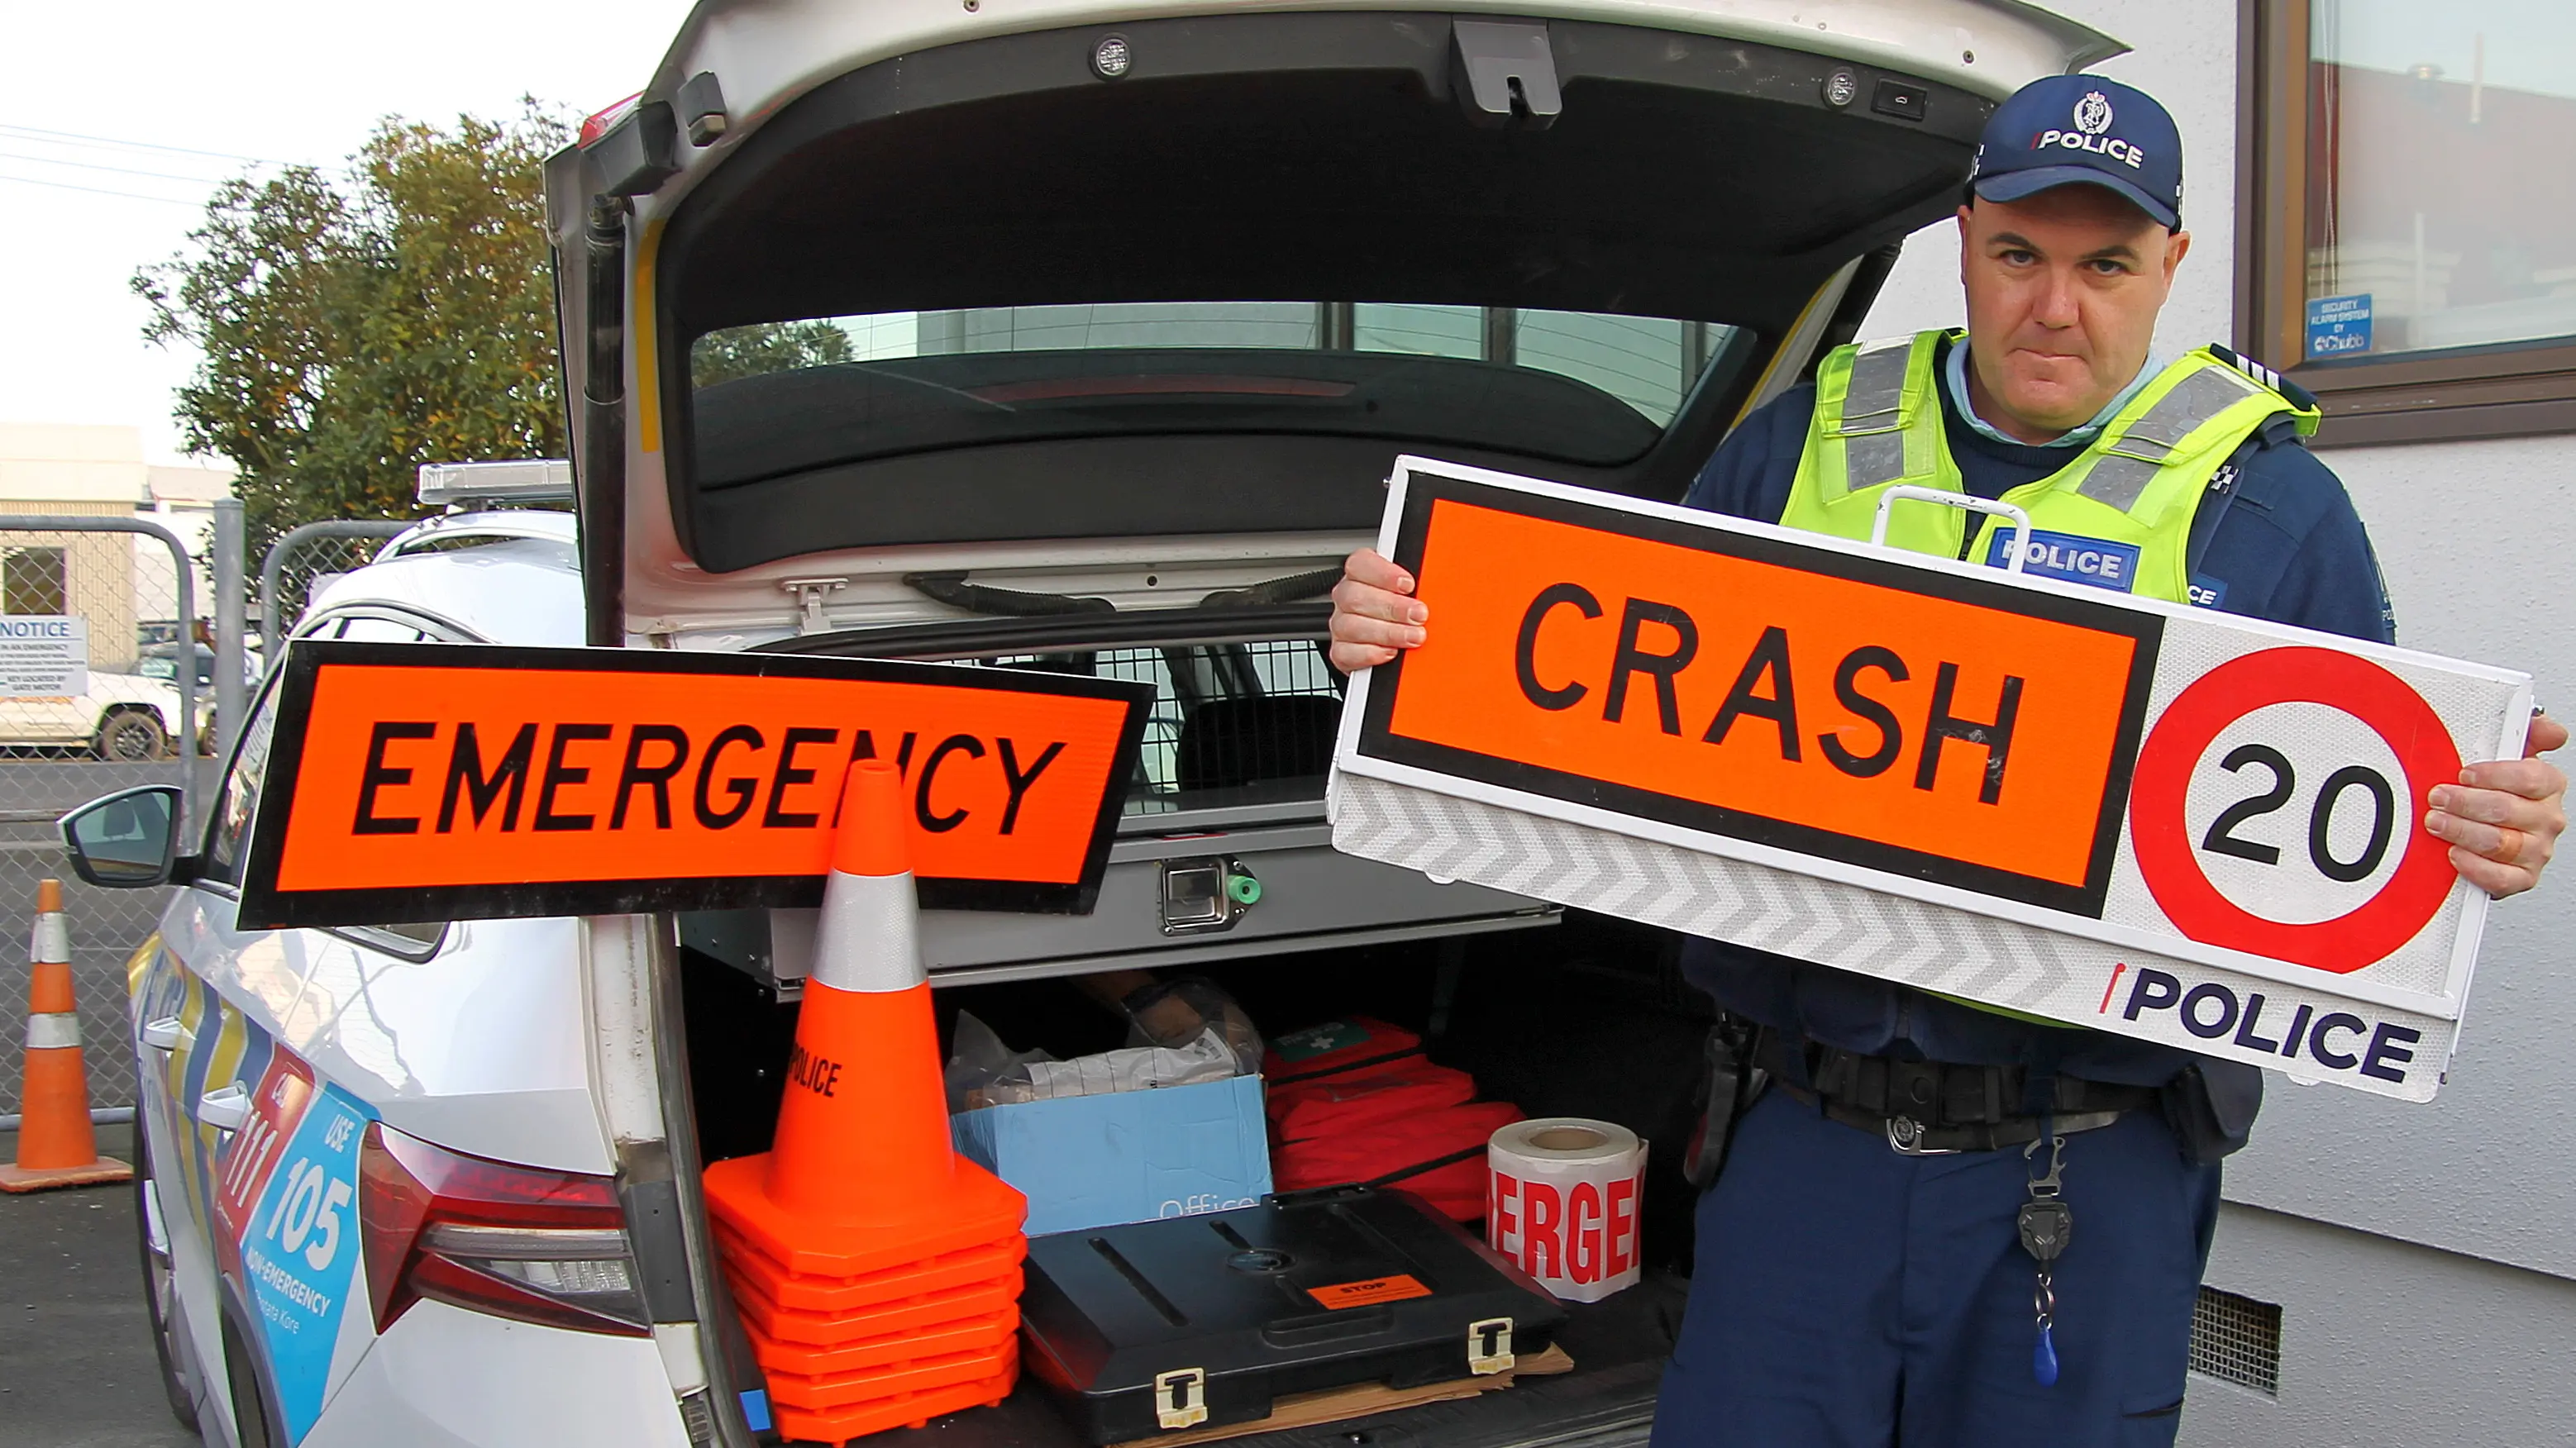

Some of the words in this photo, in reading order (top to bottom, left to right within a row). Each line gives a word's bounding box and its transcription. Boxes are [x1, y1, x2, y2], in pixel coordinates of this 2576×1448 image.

[2038, 130, 2144, 169] POLICE
[0, 622, 70, 636] NOTICE
[1515, 582, 2025, 806] CRASH
[2202, 744, 2394, 883] 20
[2123, 968, 2421, 1084] POLICE
[226, 1111, 278, 1207] 111
[324, 1113, 355, 1153] USE
[265, 1157, 353, 1271] 105
[1488, 1166, 1644, 1284] ERGE
[245, 1246, 331, 1317] NON-EMERGENCY
[279, 1309, 299, 1334] Kore
[1340, 1283, 1386, 1293] STOP
